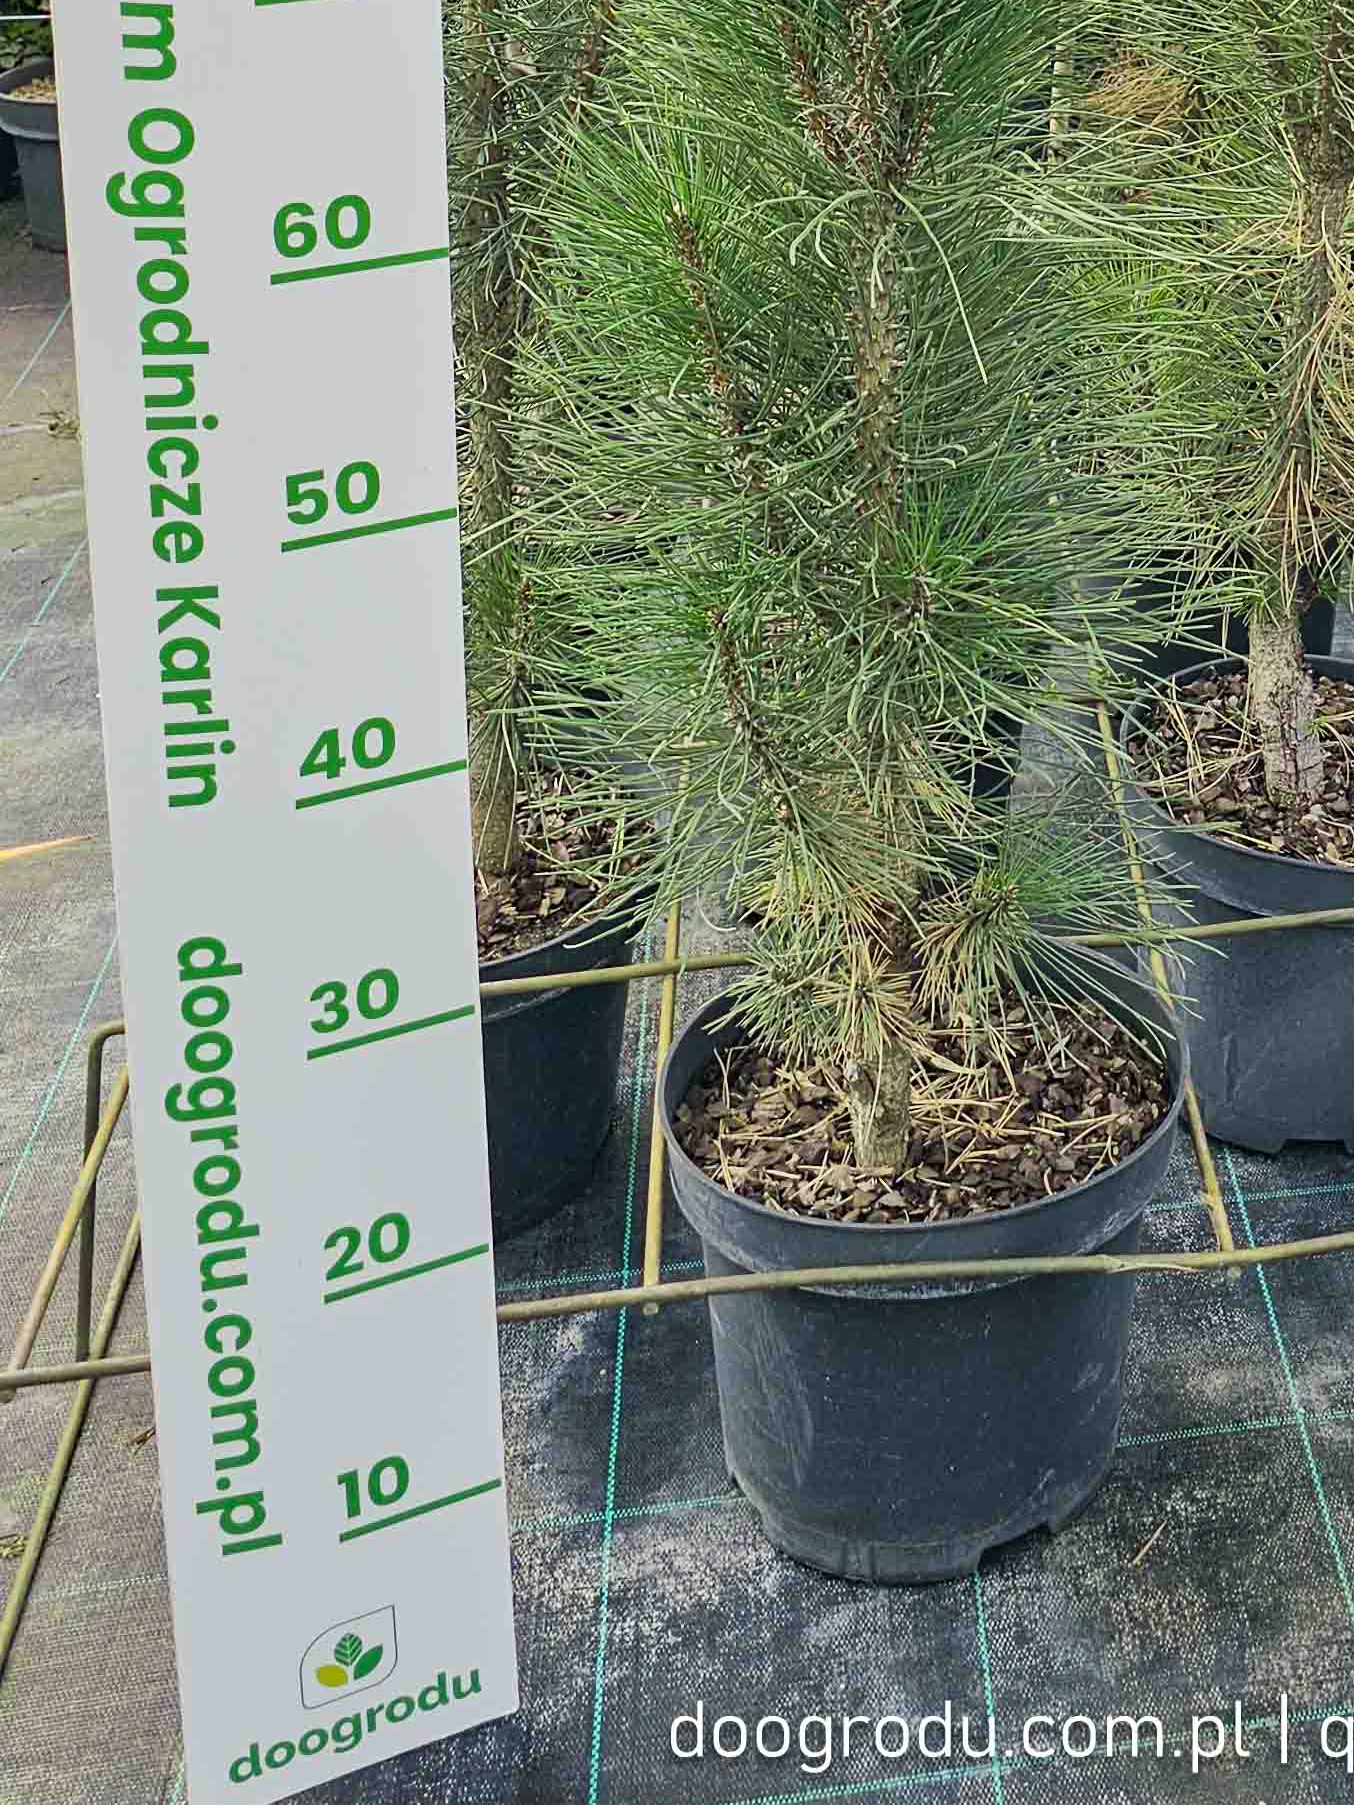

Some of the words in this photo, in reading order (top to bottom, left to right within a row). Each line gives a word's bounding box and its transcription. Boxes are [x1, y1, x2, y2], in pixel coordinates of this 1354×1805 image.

[272, 193, 372, 259] 60
[104, 107, 219, 565] Ogrodnicze
[285, 460, 381, 526] 50
[155, 585, 236, 809] Karlin
[299, 716, 397, 781] 40
[308, 968, 401, 1035] 30
[163, 935, 284, 1557] doogrodu.com.pl
[323, 1212, 411, 1282] 20
[336, 1456, 410, 1519] 10
[227, 1667, 483, 1785] doogrodu
